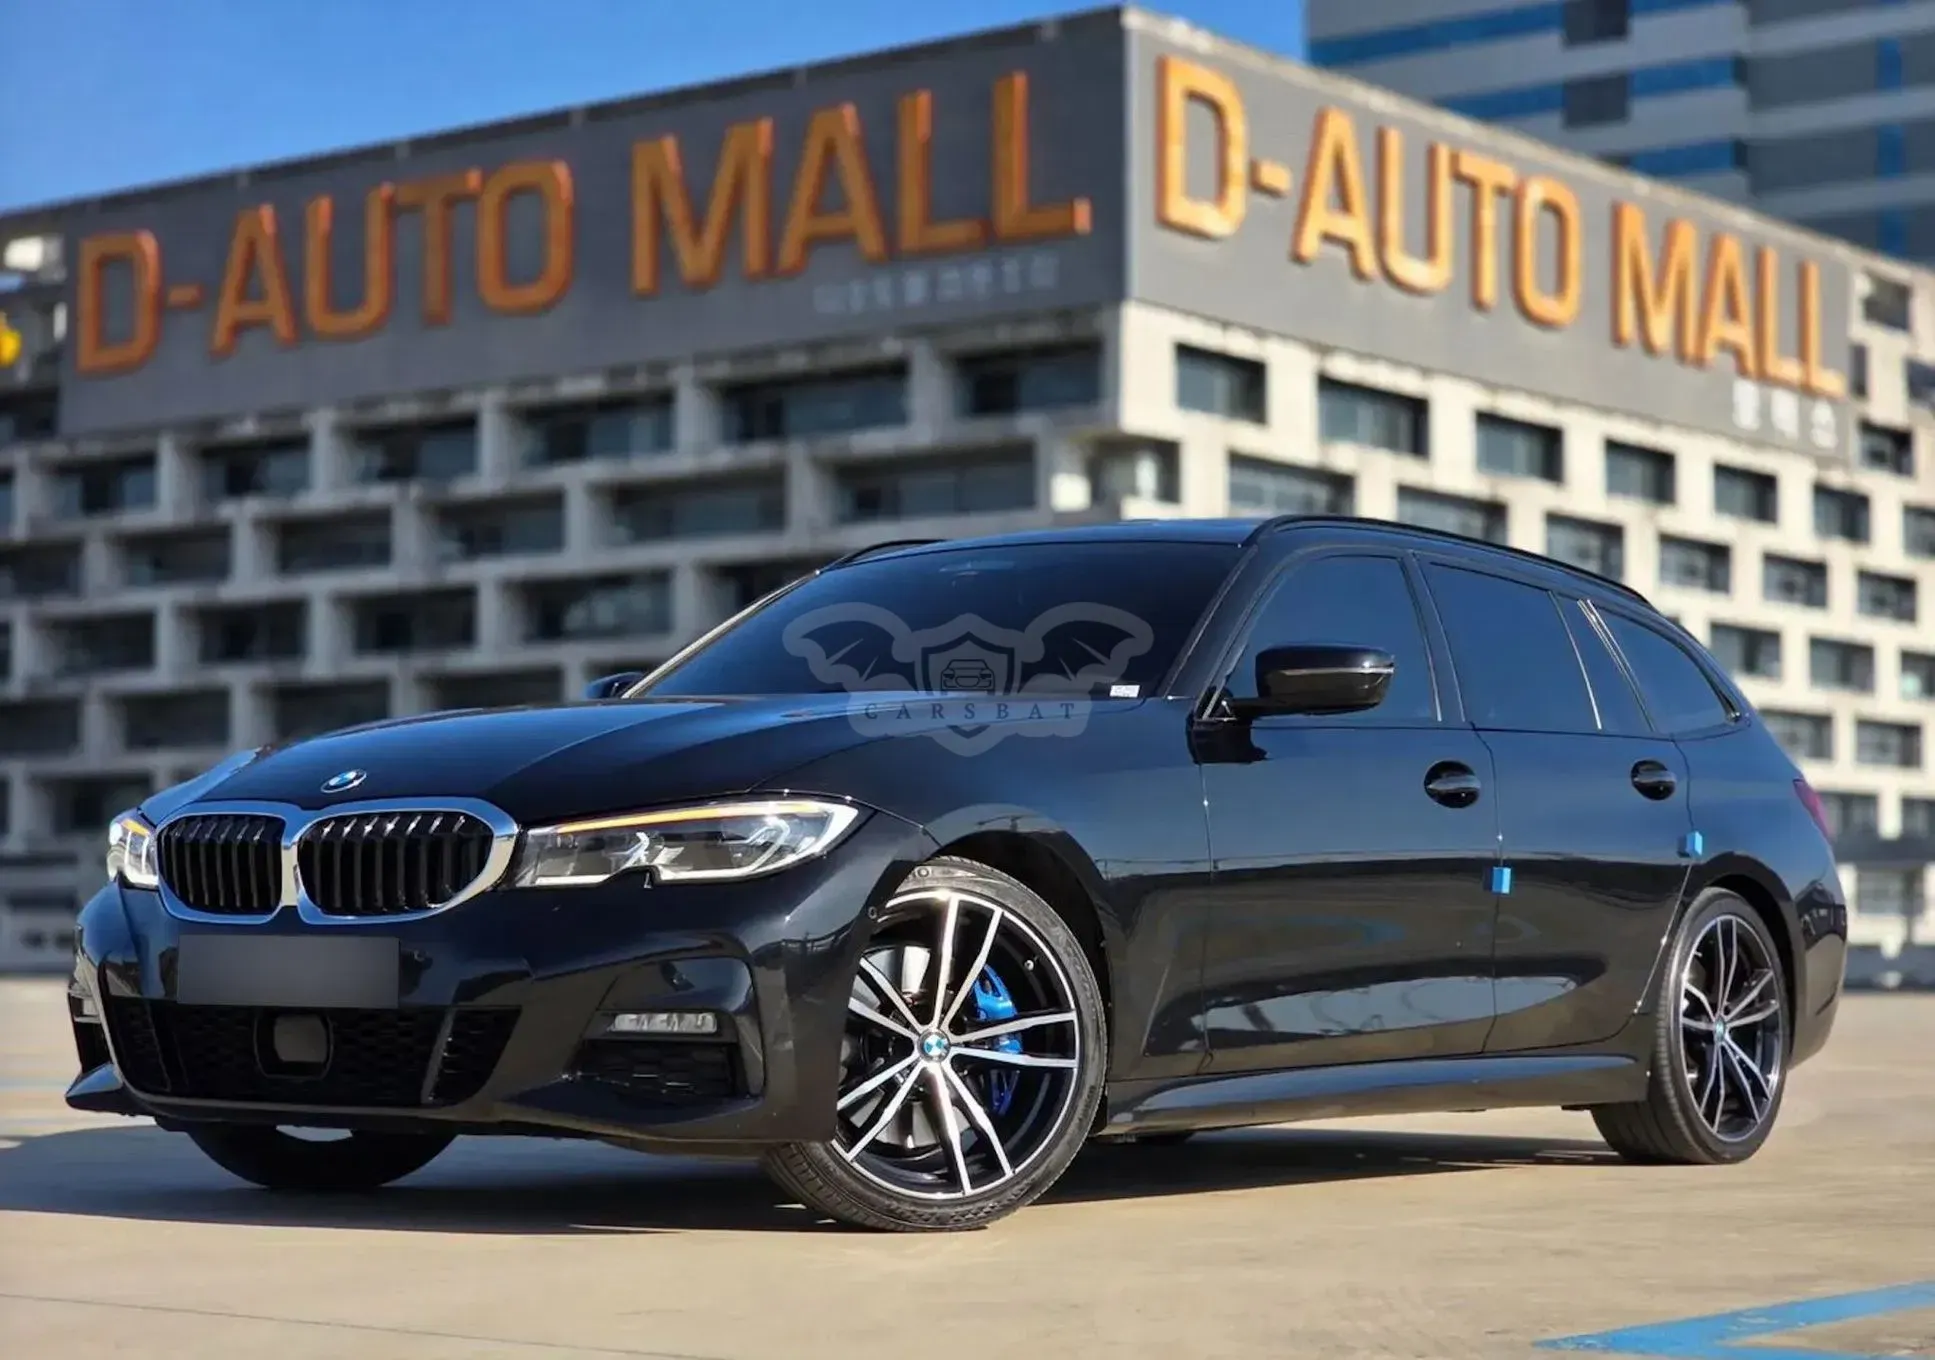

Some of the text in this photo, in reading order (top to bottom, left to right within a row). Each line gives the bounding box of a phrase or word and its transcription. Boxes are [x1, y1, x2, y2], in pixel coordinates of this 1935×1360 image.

[76, 72, 1091, 373] D-AUTO MALL
[1156, 56, 1843, 396] D-AUTO MALL
